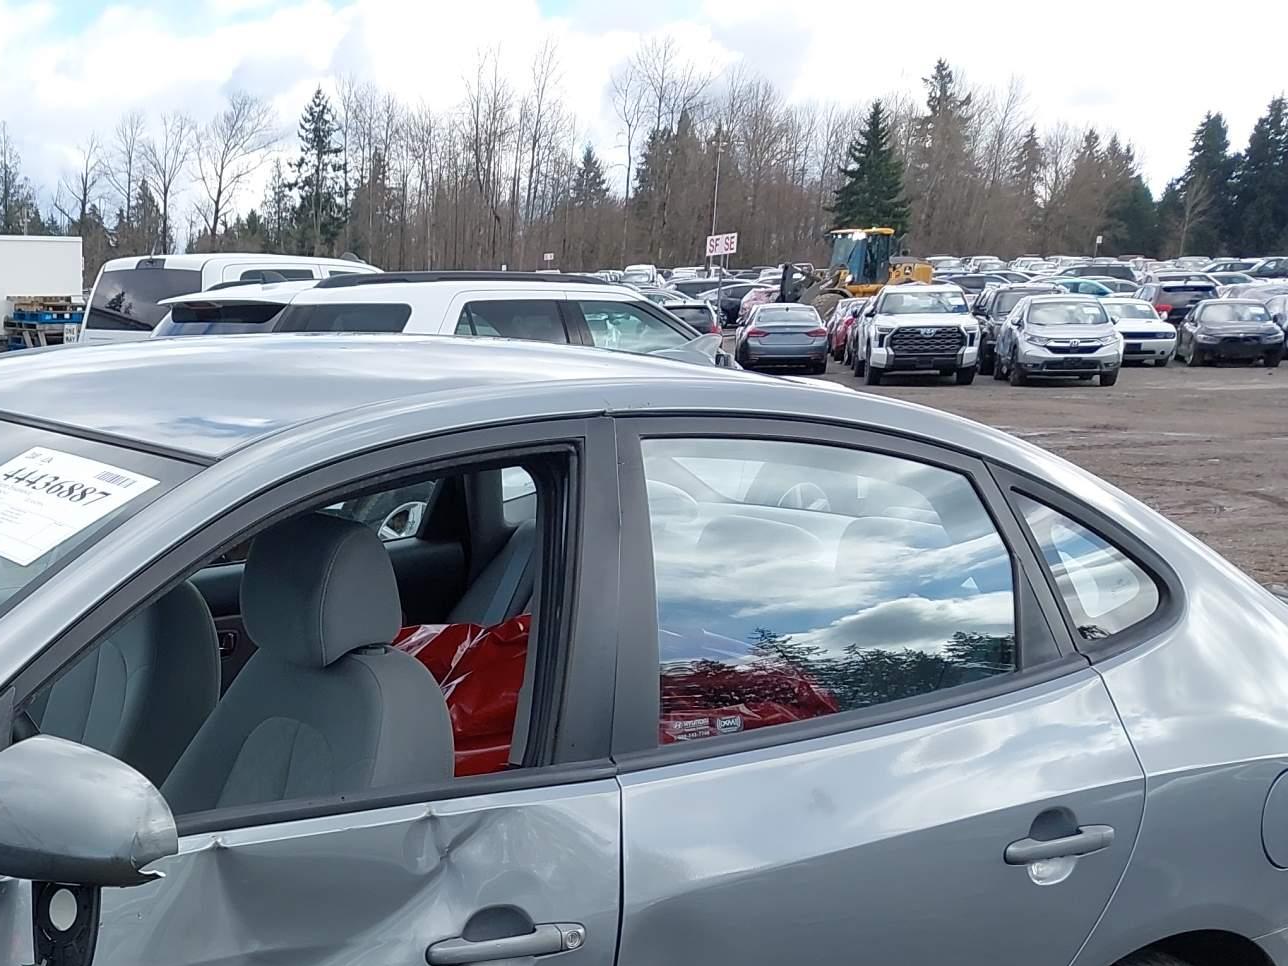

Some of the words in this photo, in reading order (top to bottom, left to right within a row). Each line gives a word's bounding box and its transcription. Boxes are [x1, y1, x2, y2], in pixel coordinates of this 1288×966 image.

[709, 237, 720, 254] SF
[724, 235, 736, 251] SE
[3, 467, 112, 506] 44436887
